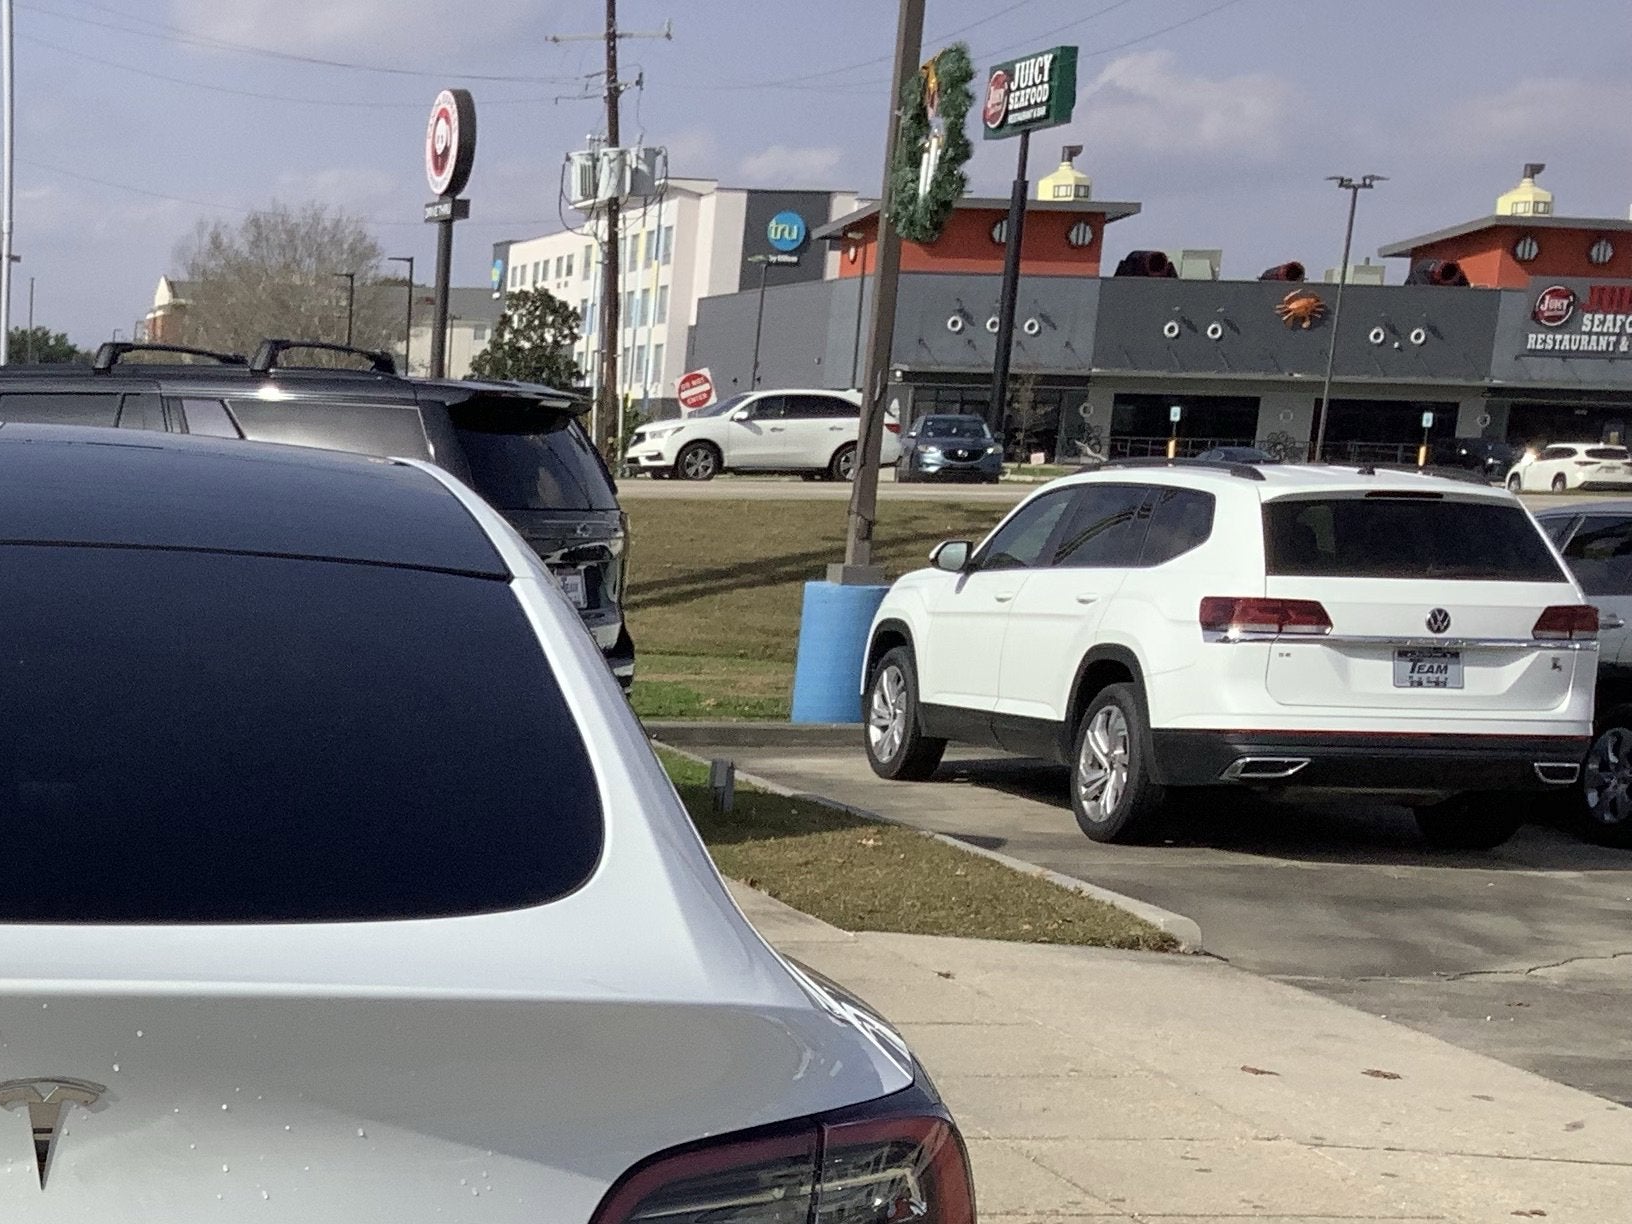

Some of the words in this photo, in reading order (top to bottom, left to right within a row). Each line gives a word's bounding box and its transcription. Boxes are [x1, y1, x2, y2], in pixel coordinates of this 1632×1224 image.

[1010, 53, 1054, 91] JUICY
[1008, 83, 1050, 110] SEAFOOD
[1527, 333, 1617, 351] RESTAURANT
[1619, 336, 1629, 352] &
